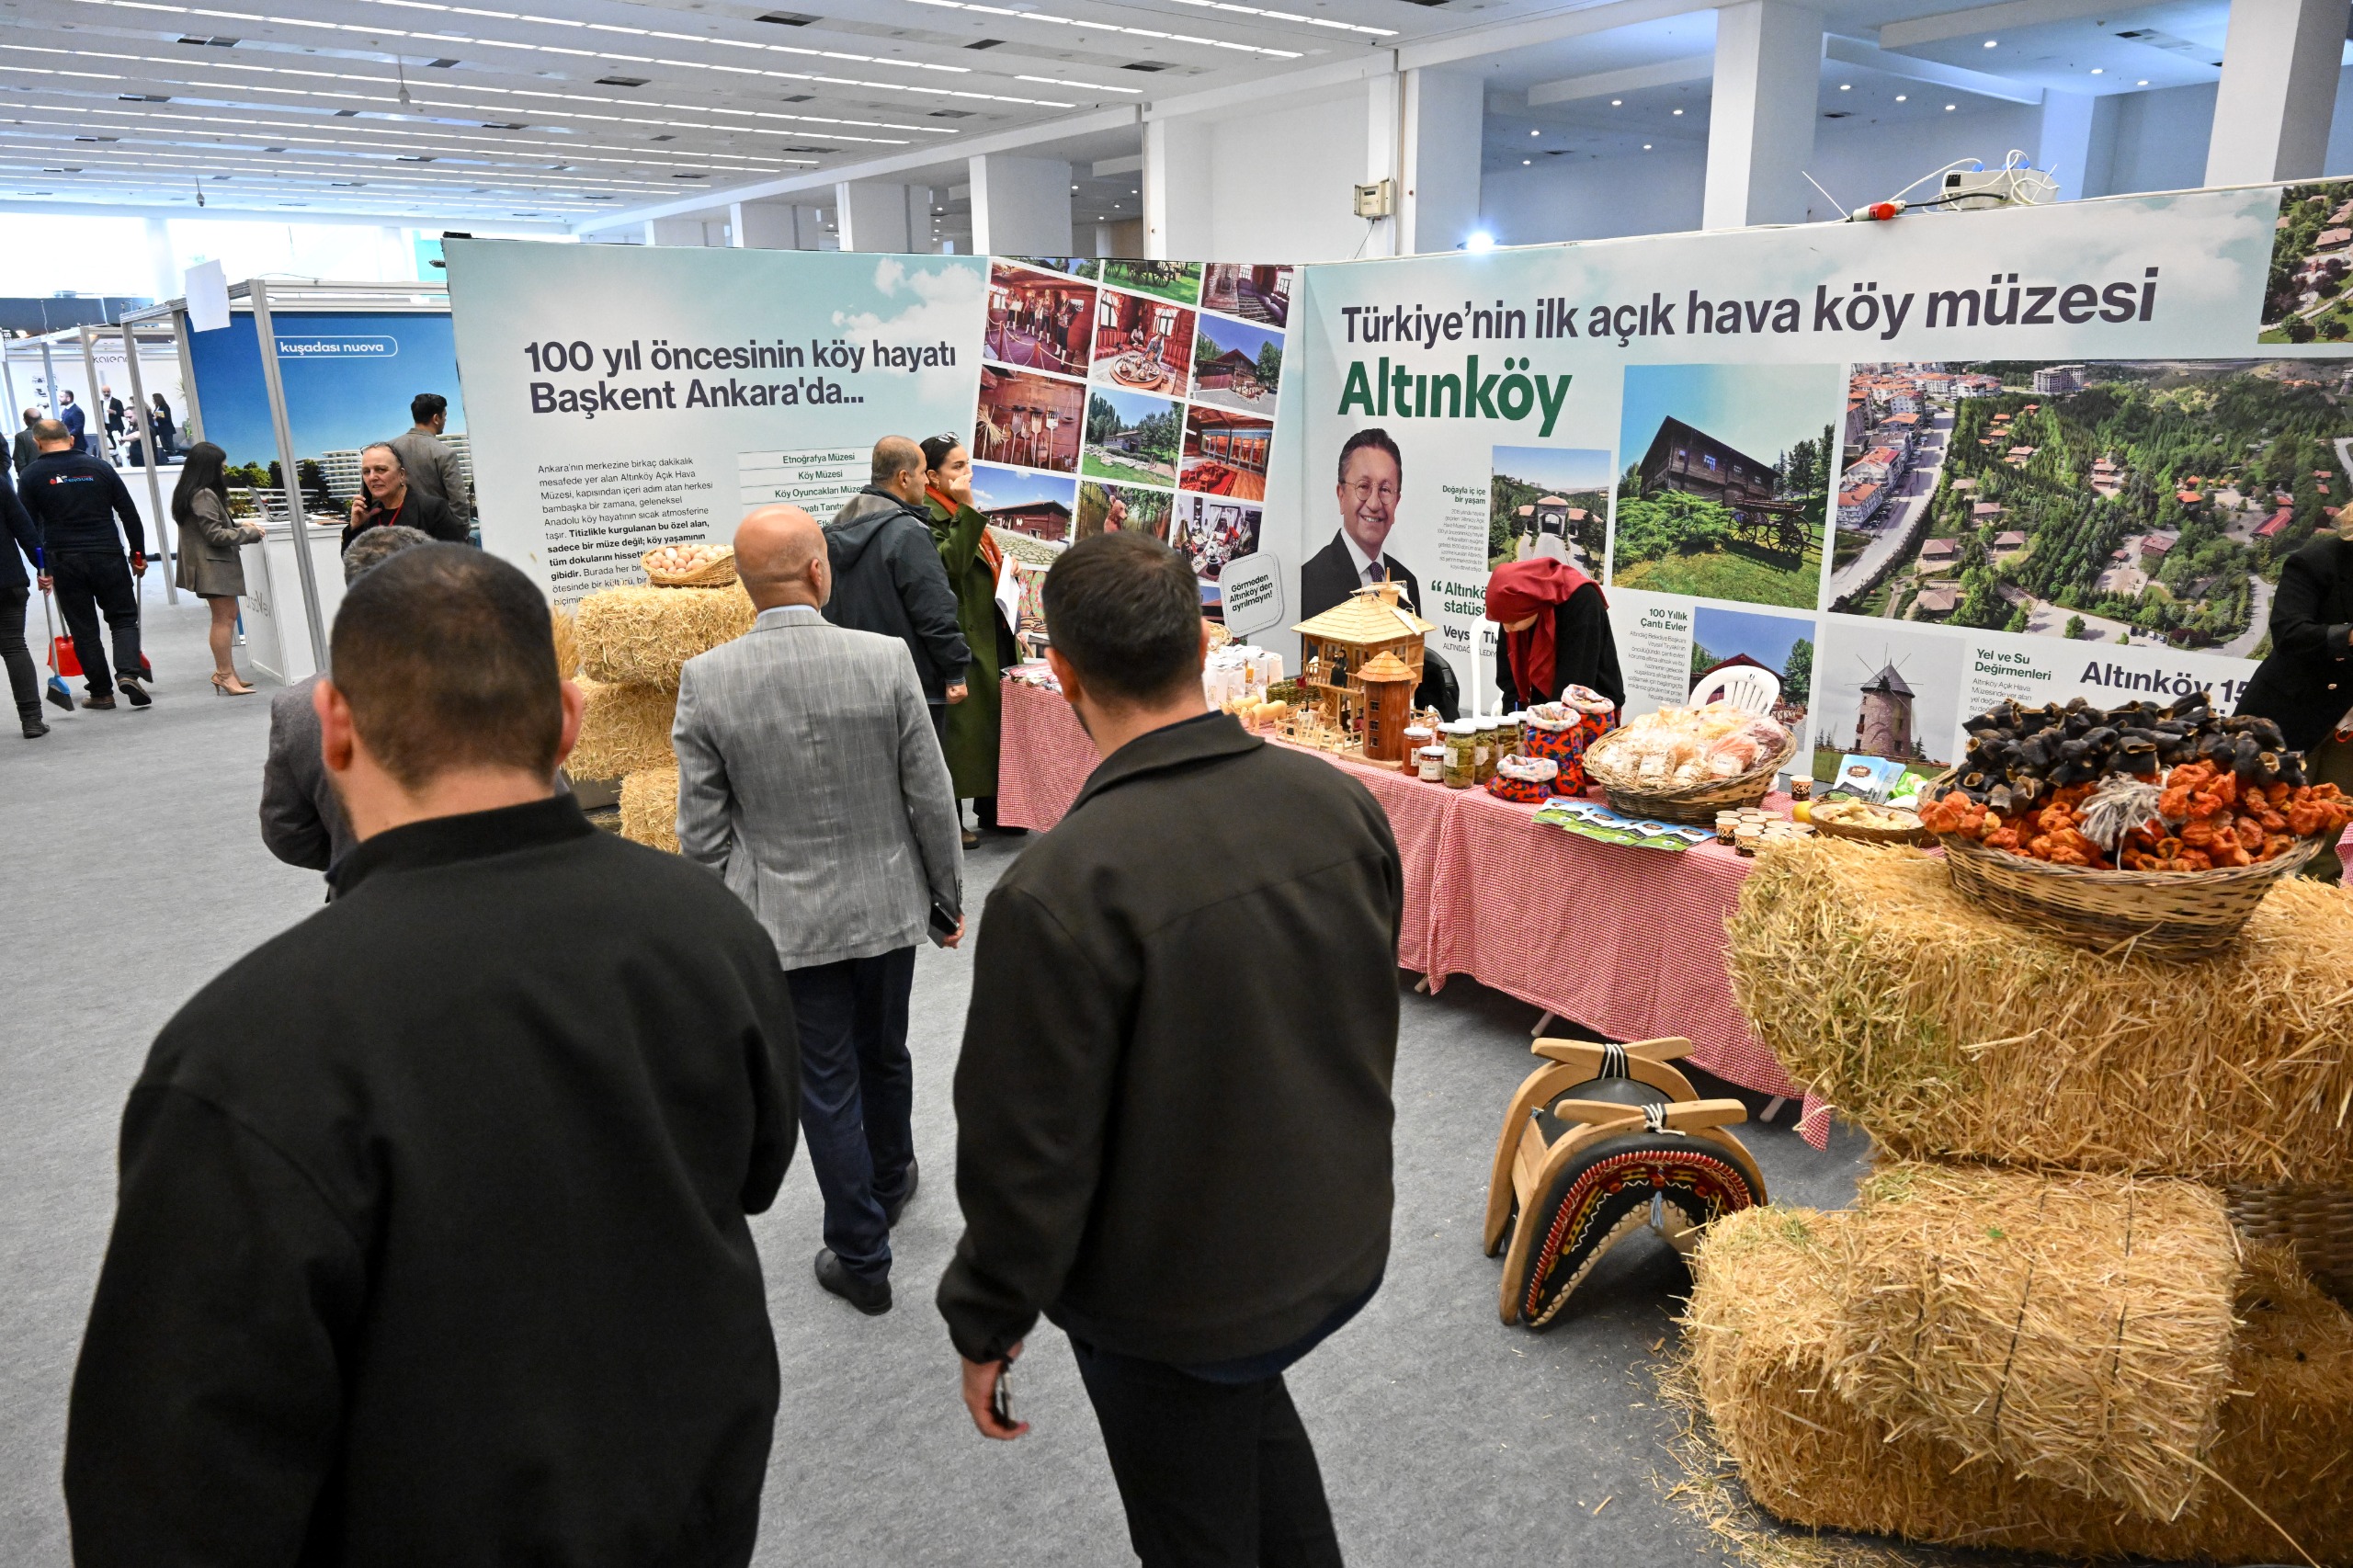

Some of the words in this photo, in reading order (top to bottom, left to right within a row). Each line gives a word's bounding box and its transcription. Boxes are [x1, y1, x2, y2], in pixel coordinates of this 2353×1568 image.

[1341, 300, 1527, 350] Türkiye’nin
[1535, 297, 1580, 339] ilk
[1587, 292, 1677, 348] açık
[1686, 290, 1801, 335] hava
[1813, 281, 1915, 341] köy
[1925, 266, 2159, 328] müzesi
[279, 341, 340, 356] kuşadası
[343, 343, 384, 352] nuova
[524, 340, 594, 373] 100
[602, 339, 642, 378] yıl
[650, 339, 804, 370] öncesinin
[812, 339, 866, 373] köy
[872, 340, 956, 373] hayatı
[529, 380, 676, 419] Başkent
[685, 376, 864, 409] Ankara'da...
[1337, 354, 1573, 437] Altınköy
[538, 464, 584, 473] Ankara'nın
[585, 461, 629, 470] merkezine
[658, 458, 693, 466] dakikalık
[783, 454, 827, 465] Etnoğrafya
[828, 452, 855, 461] Müzesi
[539, 477, 583, 486] mesafede
[584, 477, 598, 485] yer
[620, 472, 653, 481] Altınköy
[655, 472, 673, 481] Açık
[798, 471, 814, 481] Köy
[816, 470, 843, 478] Müzesi
[540, 491, 574, 500] Müzesi,
[575, 488, 620, 498] kapısından
[623, 486, 641, 495] içeri
[684, 482, 712, 490] herkesi
[775, 489, 790, 498] Köy
[792, 487, 838, 498] Oyuncakları
[840, 485, 863, 494] Müzes
[1443, 485, 1468, 494] Doğayla
[1470, 487, 1474, 495] iç
[1477, 488, 1485, 496] içe
[542, 504, 586, 513] bambaşka
[603, 501, 638, 509] zamana,
[640, 496, 683, 507] geleneksel
[798, 504, 818, 513] ayatı
[820, 503, 845, 511] Tanıtı
[544, 517, 579, 526] Anadolu
[581, 516, 597, 524] köy
[598, 514, 636, 522] hayatının
[661, 507, 709, 517] atmosferine
[545, 533, 567, 541] taşır.
[568, 528, 607, 537] Titizlikle
[608, 525, 656, 534] kurgulanan
[547, 544, 580, 552] sadece
[621, 538, 645, 547] değil;
[664, 534, 705, 544] yaşamının
[569, 555, 612, 564] dokularını
[614, 551, 647, 560] hissetti
[551, 571, 581, 581] gibidir.
[583, 567, 614, 576] Burada
[552, 583, 589, 593] ötesinde
[636, 576, 647, 585] bir
[1232, 574, 1268, 592] Görmeden
[1230, 582, 1273, 603] Altınköy'den
[553, 596, 585, 607] biçimin
[1233, 590, 1273, 612] ayrılmayın!
[1650, 608, 1665, 618] 100
[1667, 610, 1688, 620] Yıllık
[1641, 618, 1663, 628] Çantı
[1665, 621, 1687, 631] Evler
[1443, 625, 1470, 642] Veys
[1483, 631, 1498, 644] Ti
[1977, 649, 1994, 660] Yel
[1997, 653, 2011, 662] ve
[2014, 653, 2029, 664] Su
[1975, 662, 2052, 680] Değirmenleri
[2079, 661, 2213, 696] Altınköy
